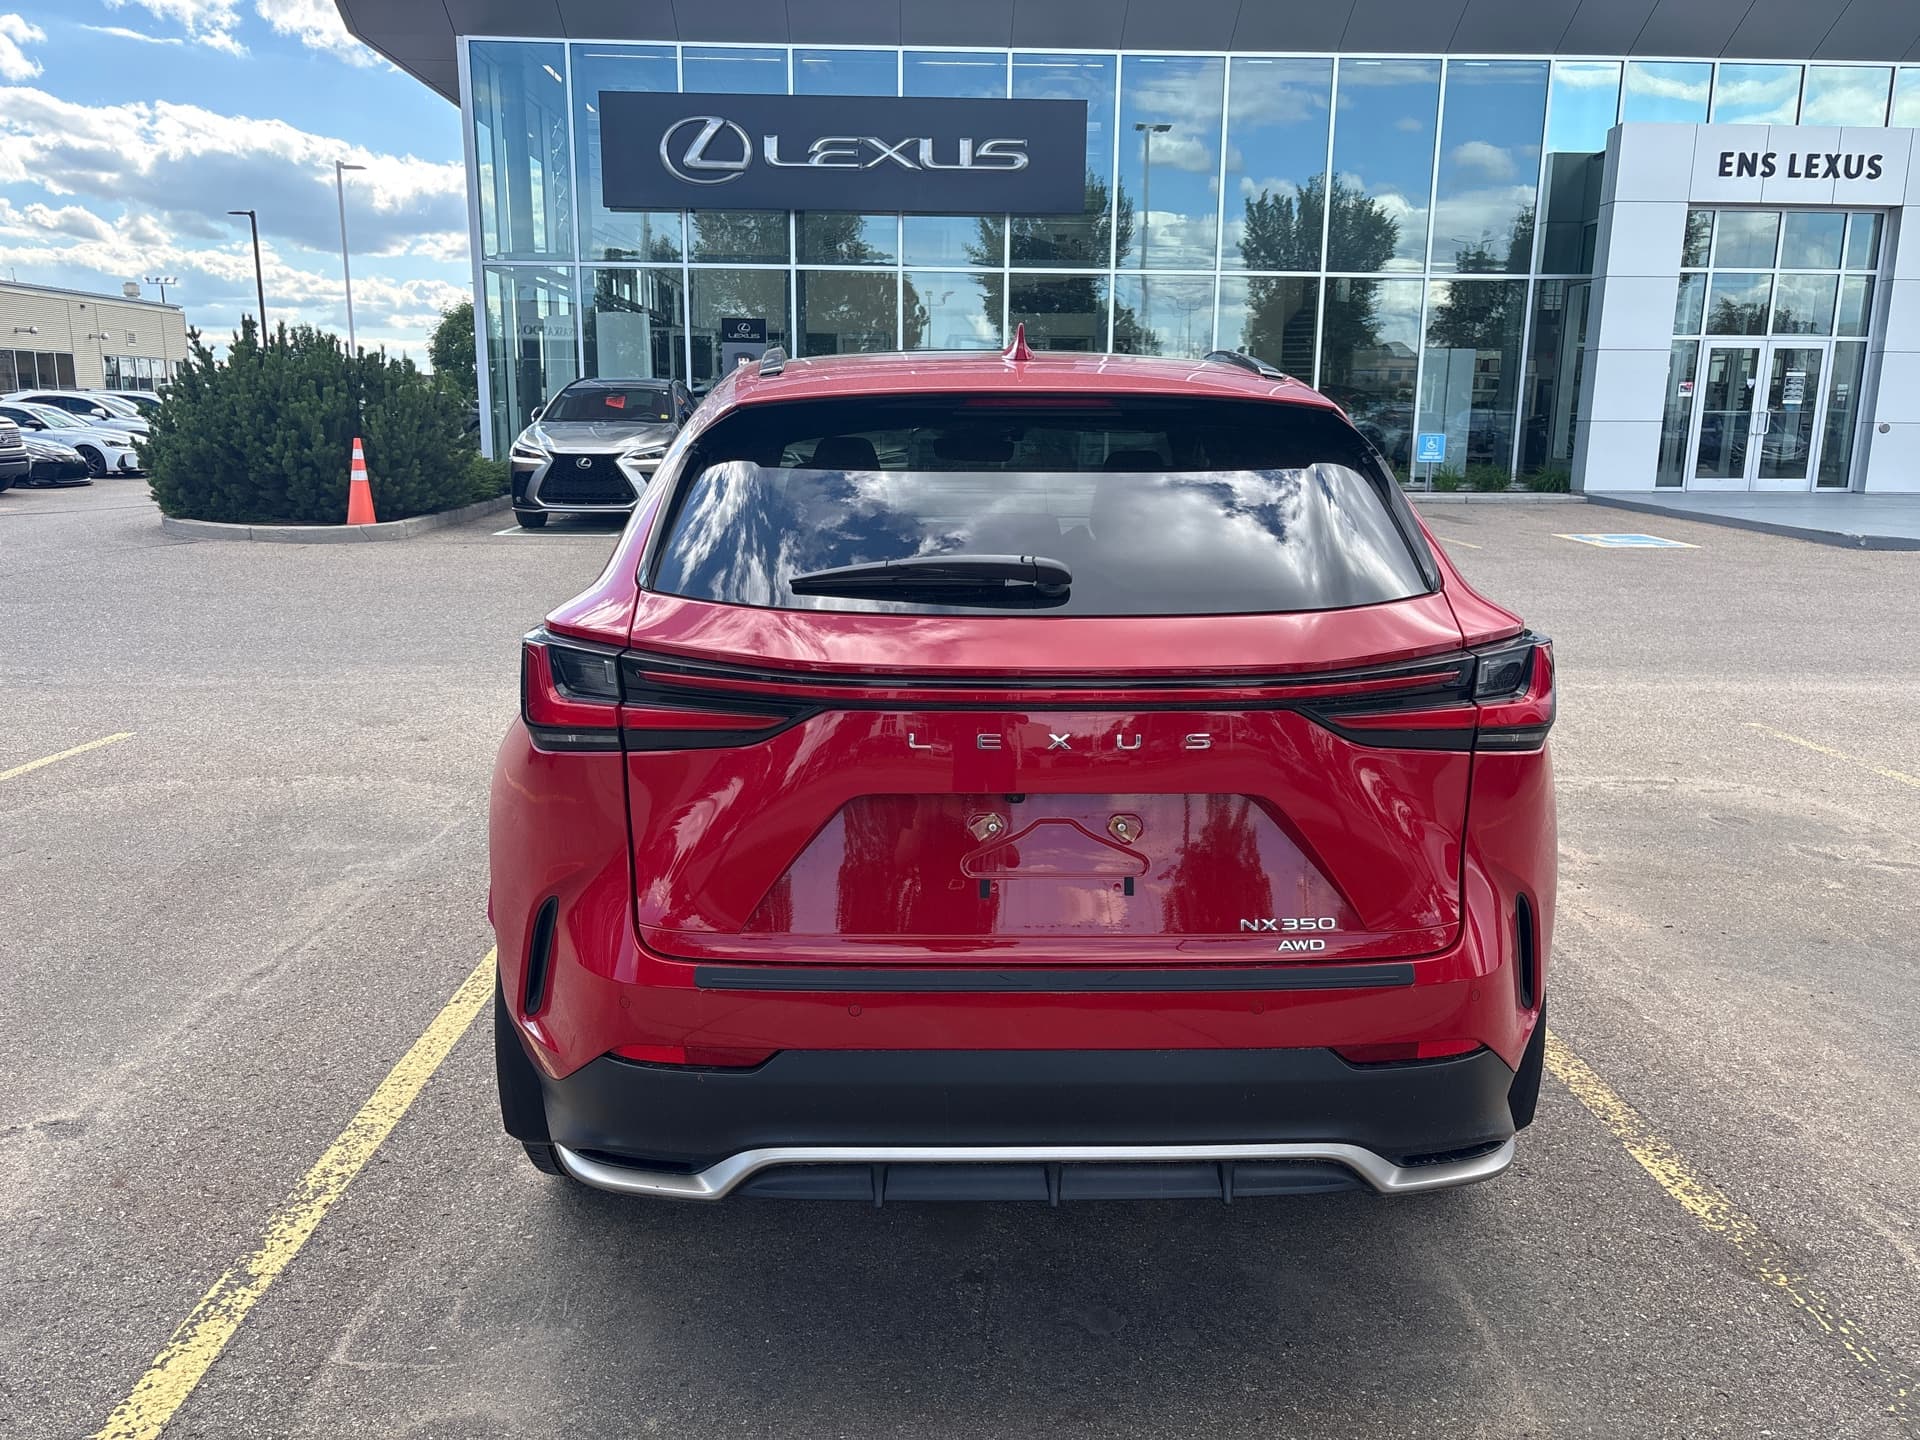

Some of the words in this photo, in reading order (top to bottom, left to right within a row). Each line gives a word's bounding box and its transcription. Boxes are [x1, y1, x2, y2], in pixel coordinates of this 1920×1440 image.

[763, 134, 1029, 171] LEXUS
[1718, 151, 1776, 178] ENS
[1787, 153, 1883, 180] LEXUS
[908, 733, 1211, 750] LEXUS
[1278, 939, 1326, 951] AWD
